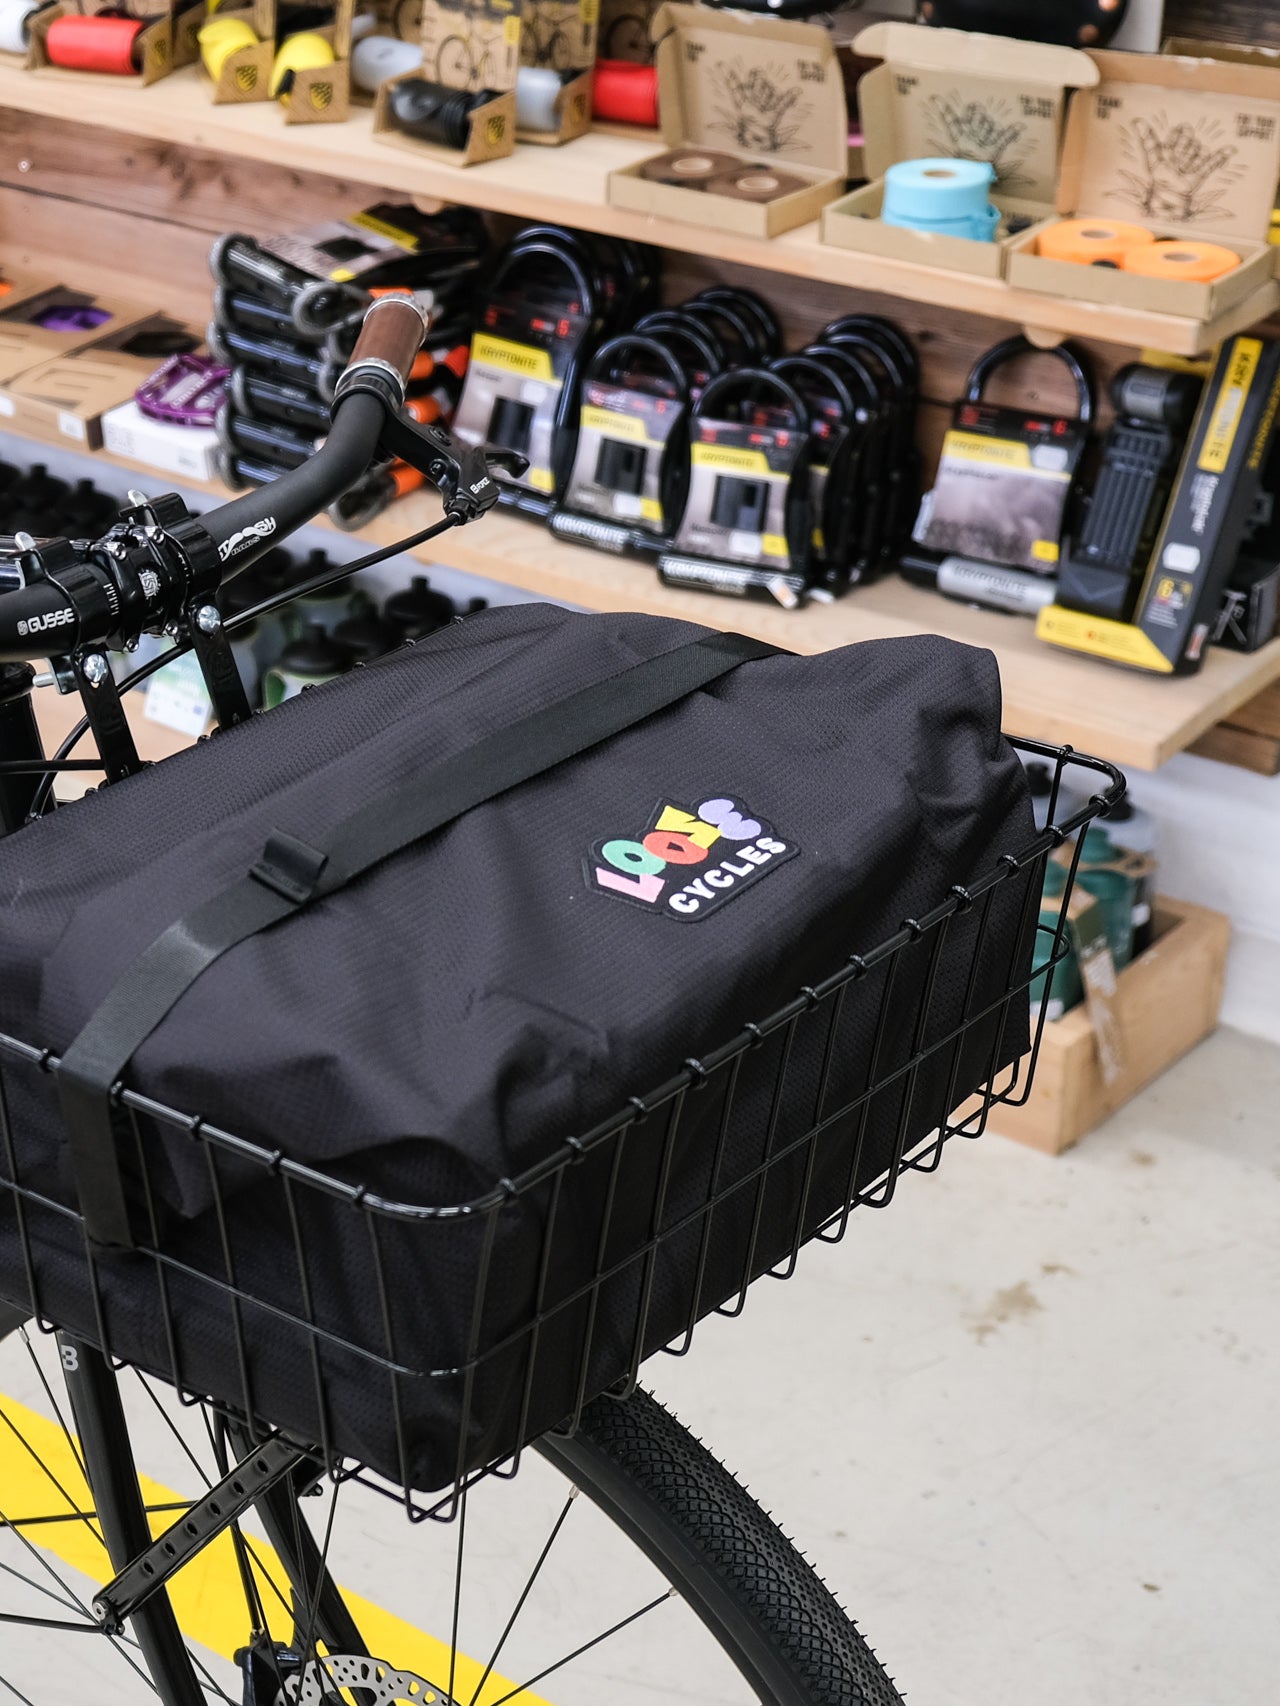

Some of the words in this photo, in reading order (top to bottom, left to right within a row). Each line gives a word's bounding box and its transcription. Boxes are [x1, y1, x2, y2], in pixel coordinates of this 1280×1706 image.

[479, 344, 538, 370] KRYPTONITE
[27, 607, 76, 633] GUSSE
[669, 837, 786, 914] CYCLES
